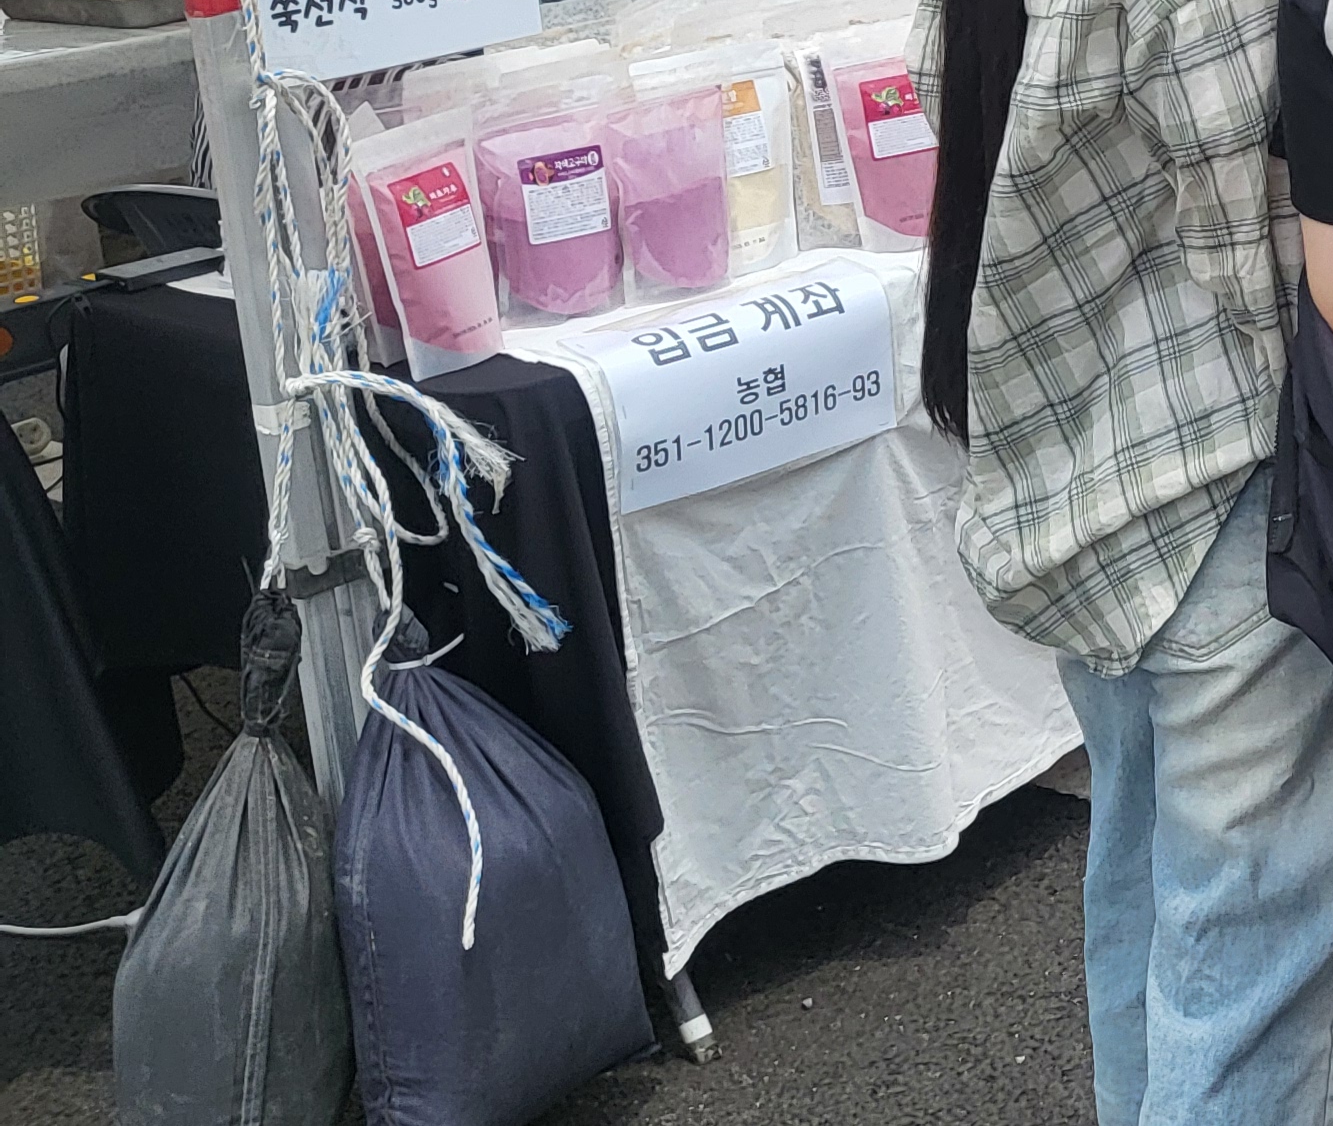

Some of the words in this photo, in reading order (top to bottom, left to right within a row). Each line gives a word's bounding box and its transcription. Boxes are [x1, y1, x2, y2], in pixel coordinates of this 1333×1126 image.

[631, 313, 739, 366] 입금
[740, 282, 846, 331] 계좌
[635, 370, 881, 472] 351-1200-5816-93
[737, 364, 786, 405] 농협
